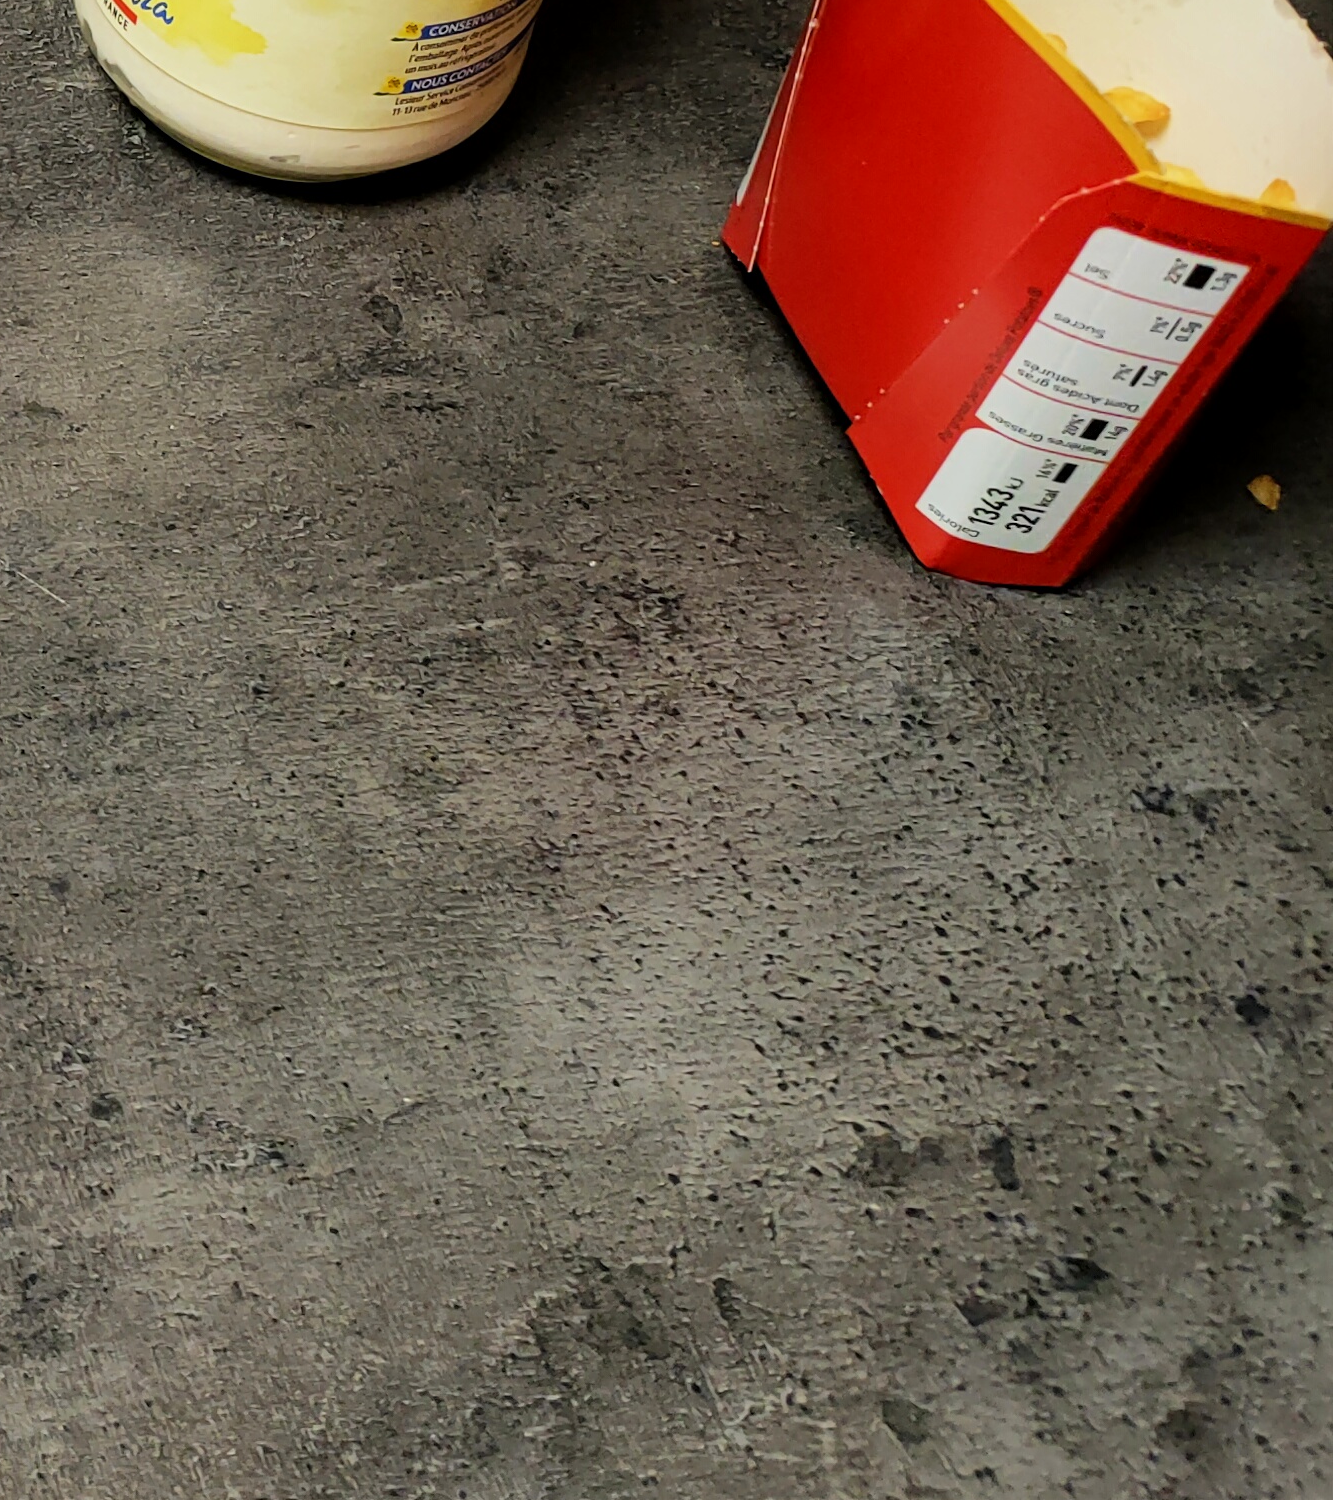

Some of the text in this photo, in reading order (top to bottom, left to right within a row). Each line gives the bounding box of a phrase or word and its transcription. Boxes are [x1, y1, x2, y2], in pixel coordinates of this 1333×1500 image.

[410, 74, 448, 92] NOUS
[1084, 263, 1110, 280] Sel
[1053, 312, 1107, 340] Sucres
[1023, 359, 1079, 386] saturés
[1017, 367, 1140, 414] Dont Acides gras
[988, 410, 1109, 457] Matières Grasses
[928, 503, 980, 538] Calories
